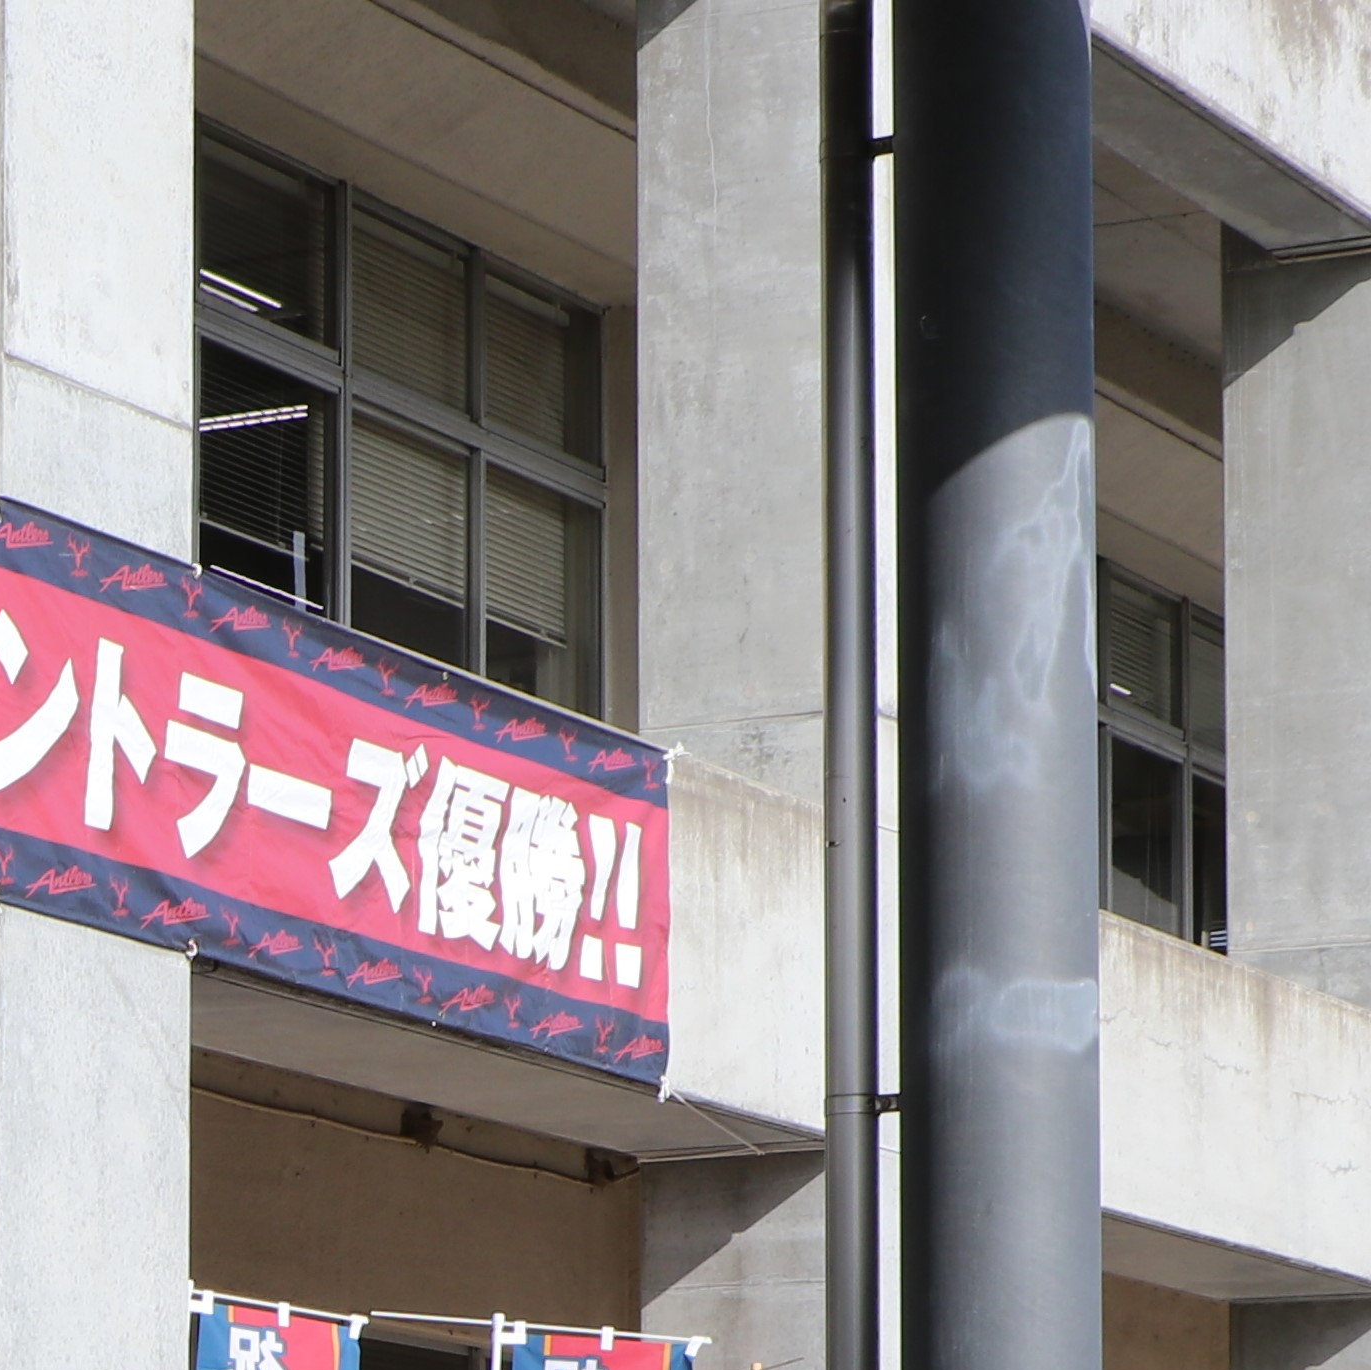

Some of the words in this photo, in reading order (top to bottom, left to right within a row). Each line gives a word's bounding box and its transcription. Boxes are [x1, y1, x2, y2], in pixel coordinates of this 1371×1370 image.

[100, 563, 168, 592] Antlers
[210, 605, 271, 632] Antlers
[310, 646, 365, 671] Antlers
[404, 682, 459, 709] Antlers
[495, 716, 548, 742] Antlers
[589, 747, 637, 773] Antlers
[25, 865, 96, 898] Antlers
[140, 897, 211, 930] Antlers
[248, 929, 303, 958] Antlers
[346, 957, 403, 988] Antlers
